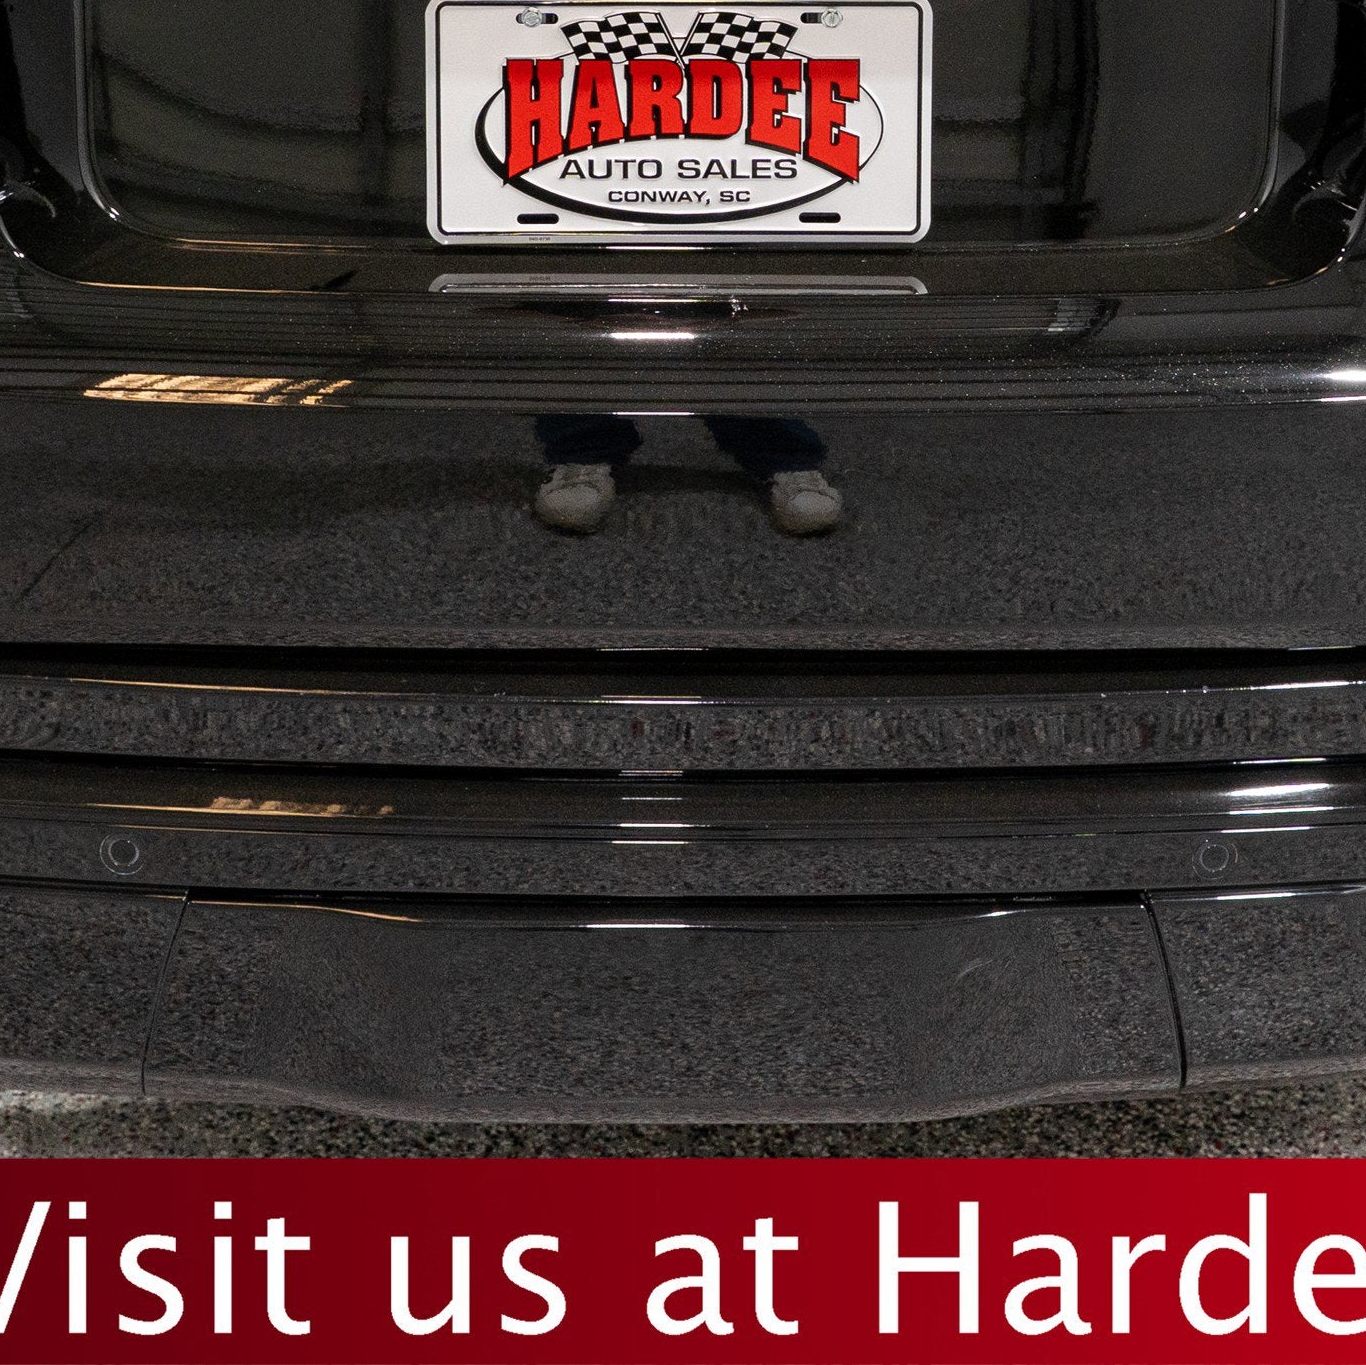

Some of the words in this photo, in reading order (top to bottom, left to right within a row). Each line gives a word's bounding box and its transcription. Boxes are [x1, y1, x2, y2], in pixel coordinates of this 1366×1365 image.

[503, 58, 861, 185] HARDEE
[559, 158, 664, 180] AUTO
[677, 158, 798, 180] SALES
[607, 189, 712, 205] CONWAY,
[719, 189, 752, 204] SC
